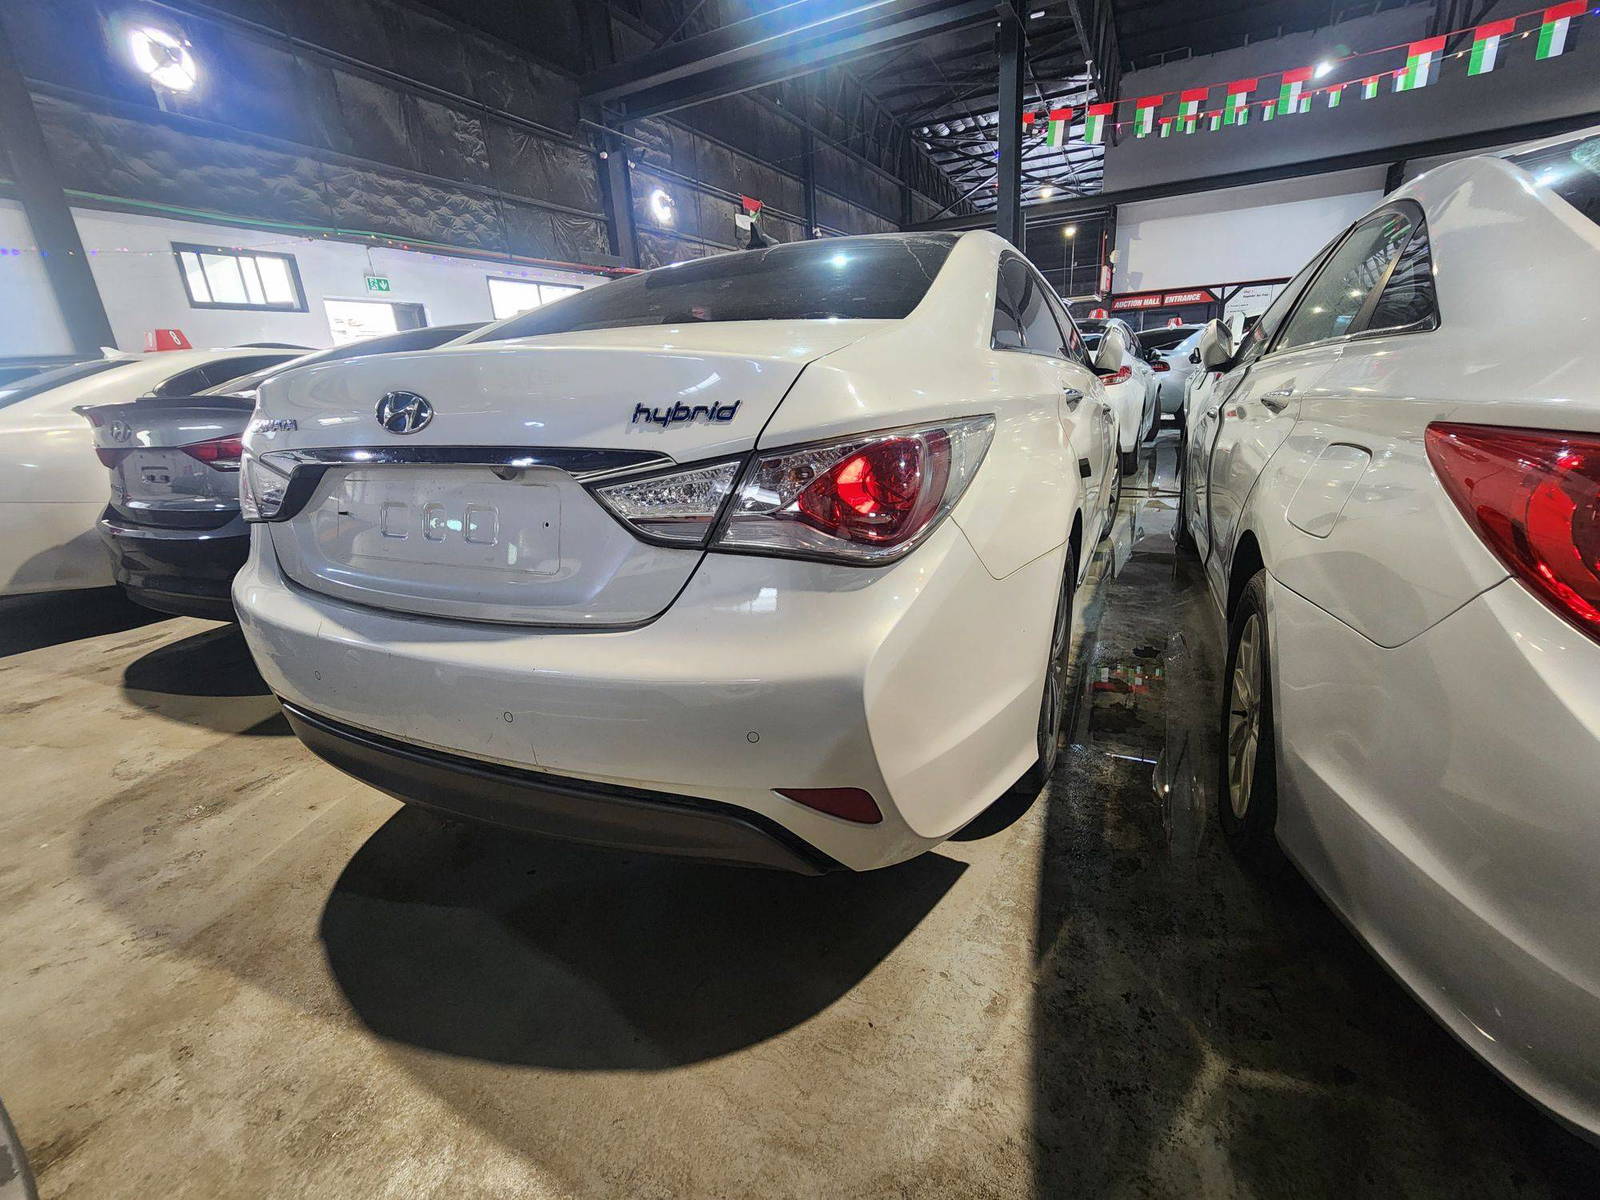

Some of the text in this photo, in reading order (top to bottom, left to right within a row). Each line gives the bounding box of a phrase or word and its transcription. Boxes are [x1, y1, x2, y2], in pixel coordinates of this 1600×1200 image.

[1114, 293, 1201, 308] AUCTION HALL ENTRANCE
[632, 400, 741, 428] hybrid
